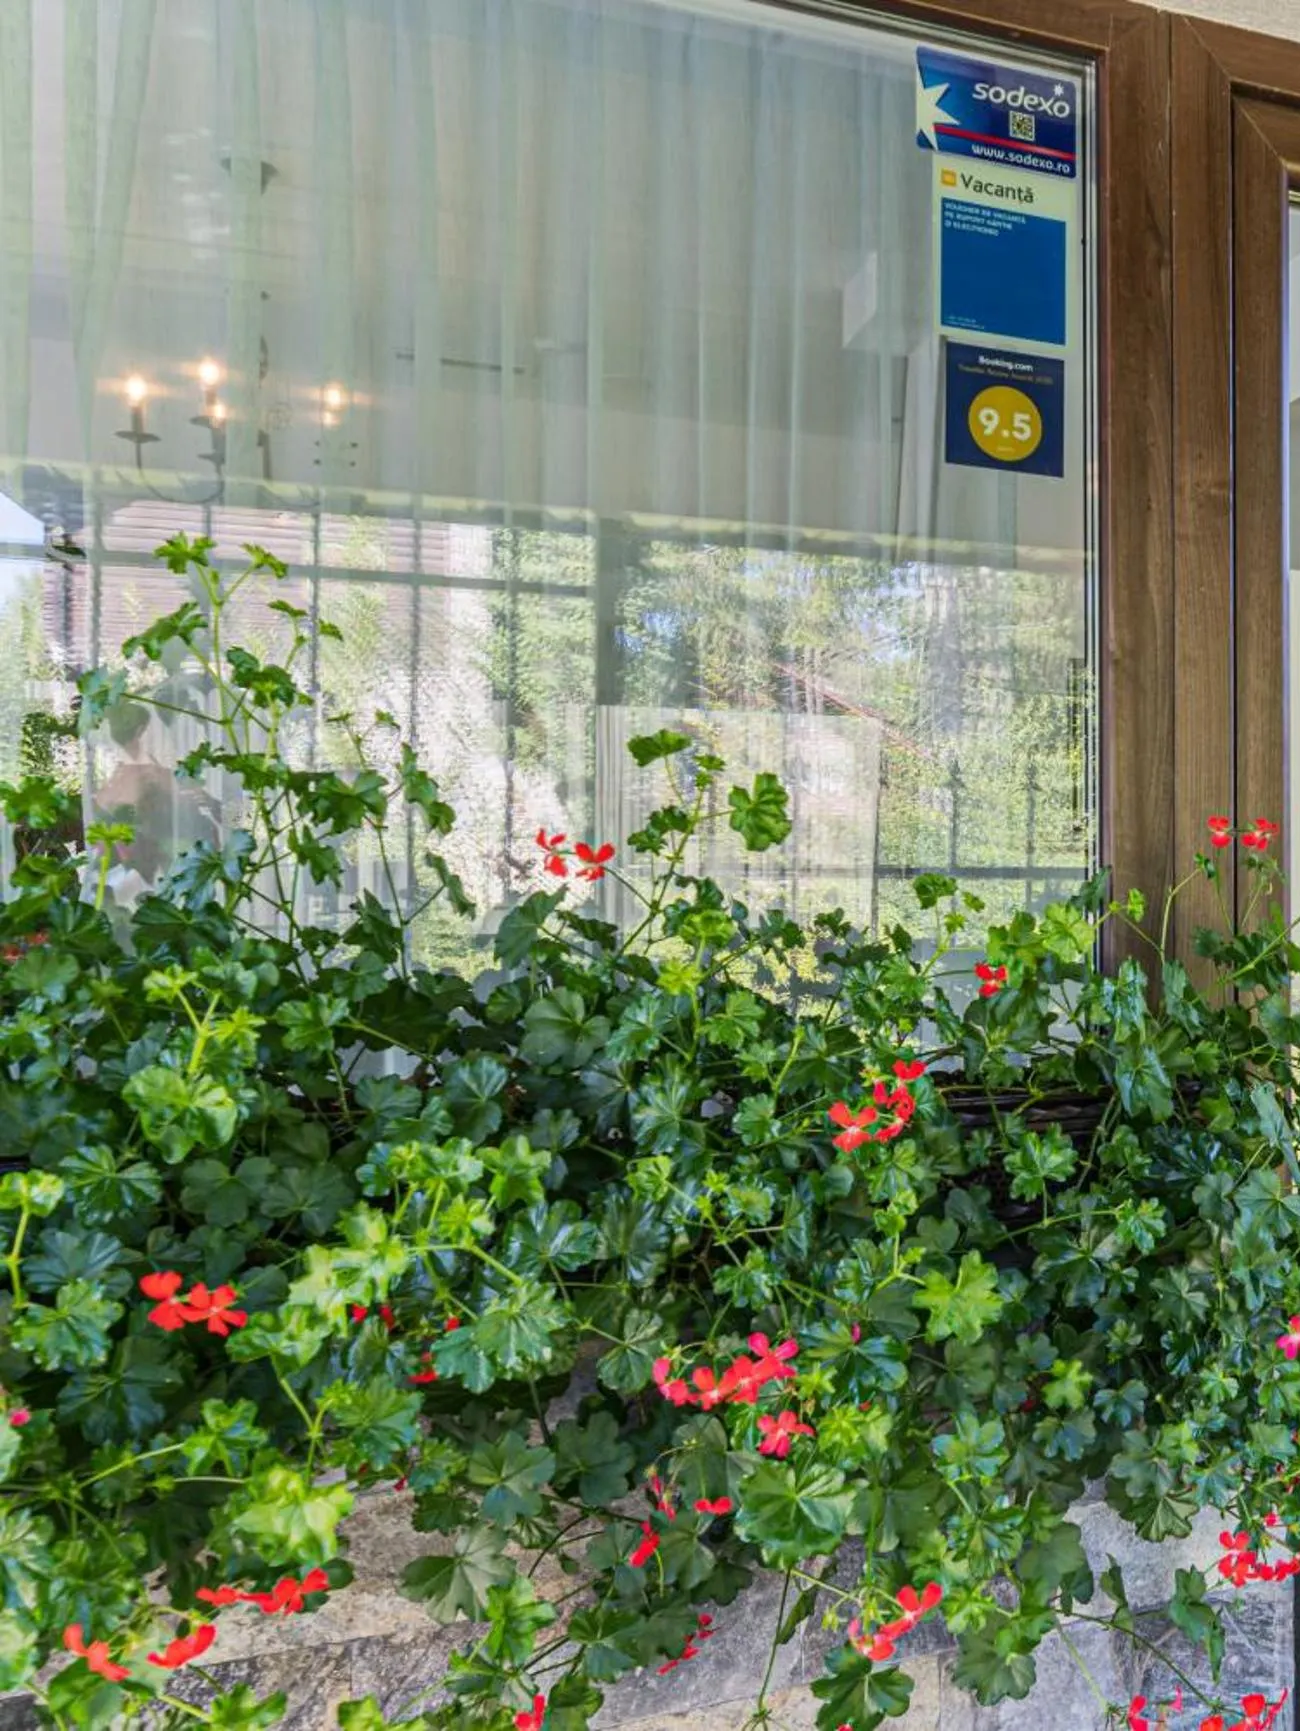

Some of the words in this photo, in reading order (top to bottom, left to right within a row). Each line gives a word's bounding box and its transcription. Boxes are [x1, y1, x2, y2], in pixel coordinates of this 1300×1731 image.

[972, 82, 1070, 118] sodexo
[971, 143, 1070, 174] www.sodexo.ro
[978, 407, 1032, 441] 9.5
